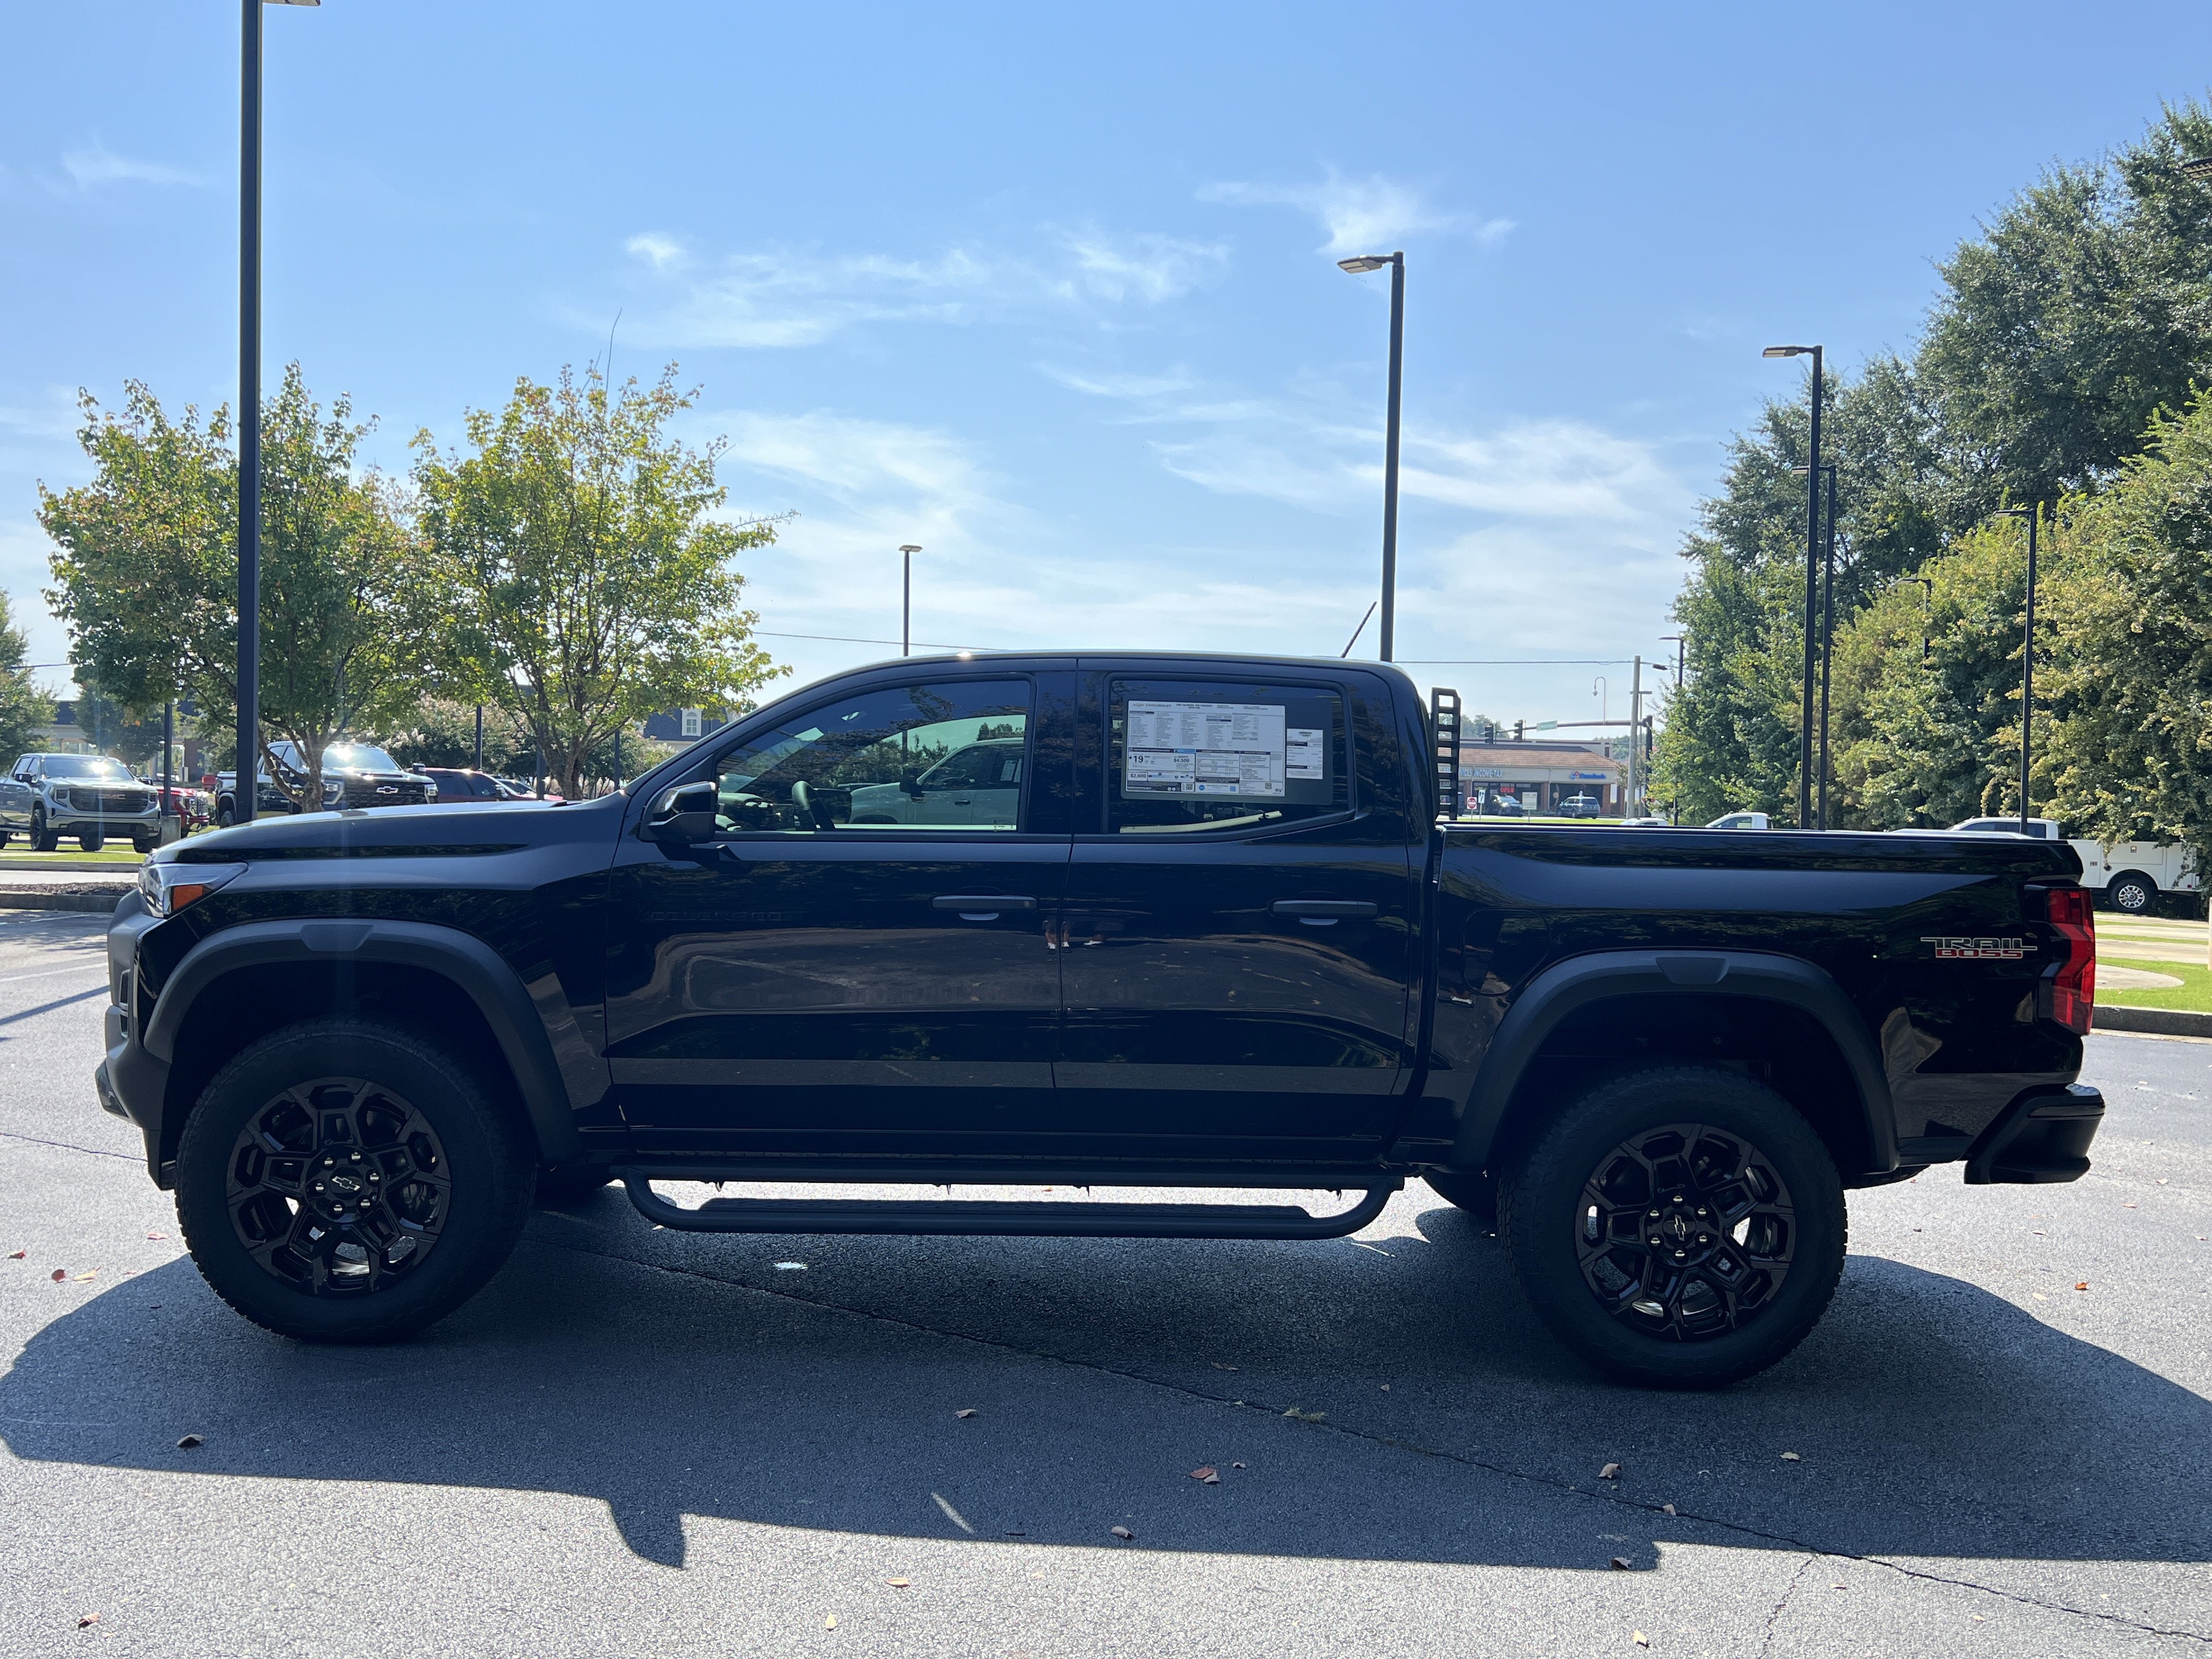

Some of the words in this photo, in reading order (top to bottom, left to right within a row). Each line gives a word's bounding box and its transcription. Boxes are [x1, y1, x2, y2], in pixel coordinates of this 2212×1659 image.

[1459, 769, 1472, 777] VICES
[1493, 769, 1503, 778] TAX
[651, 911, 782, 921] COLORADO
[1920, 936, 2038, 951] TRAIL
[1936, 949, 2023, 959] BOSS
